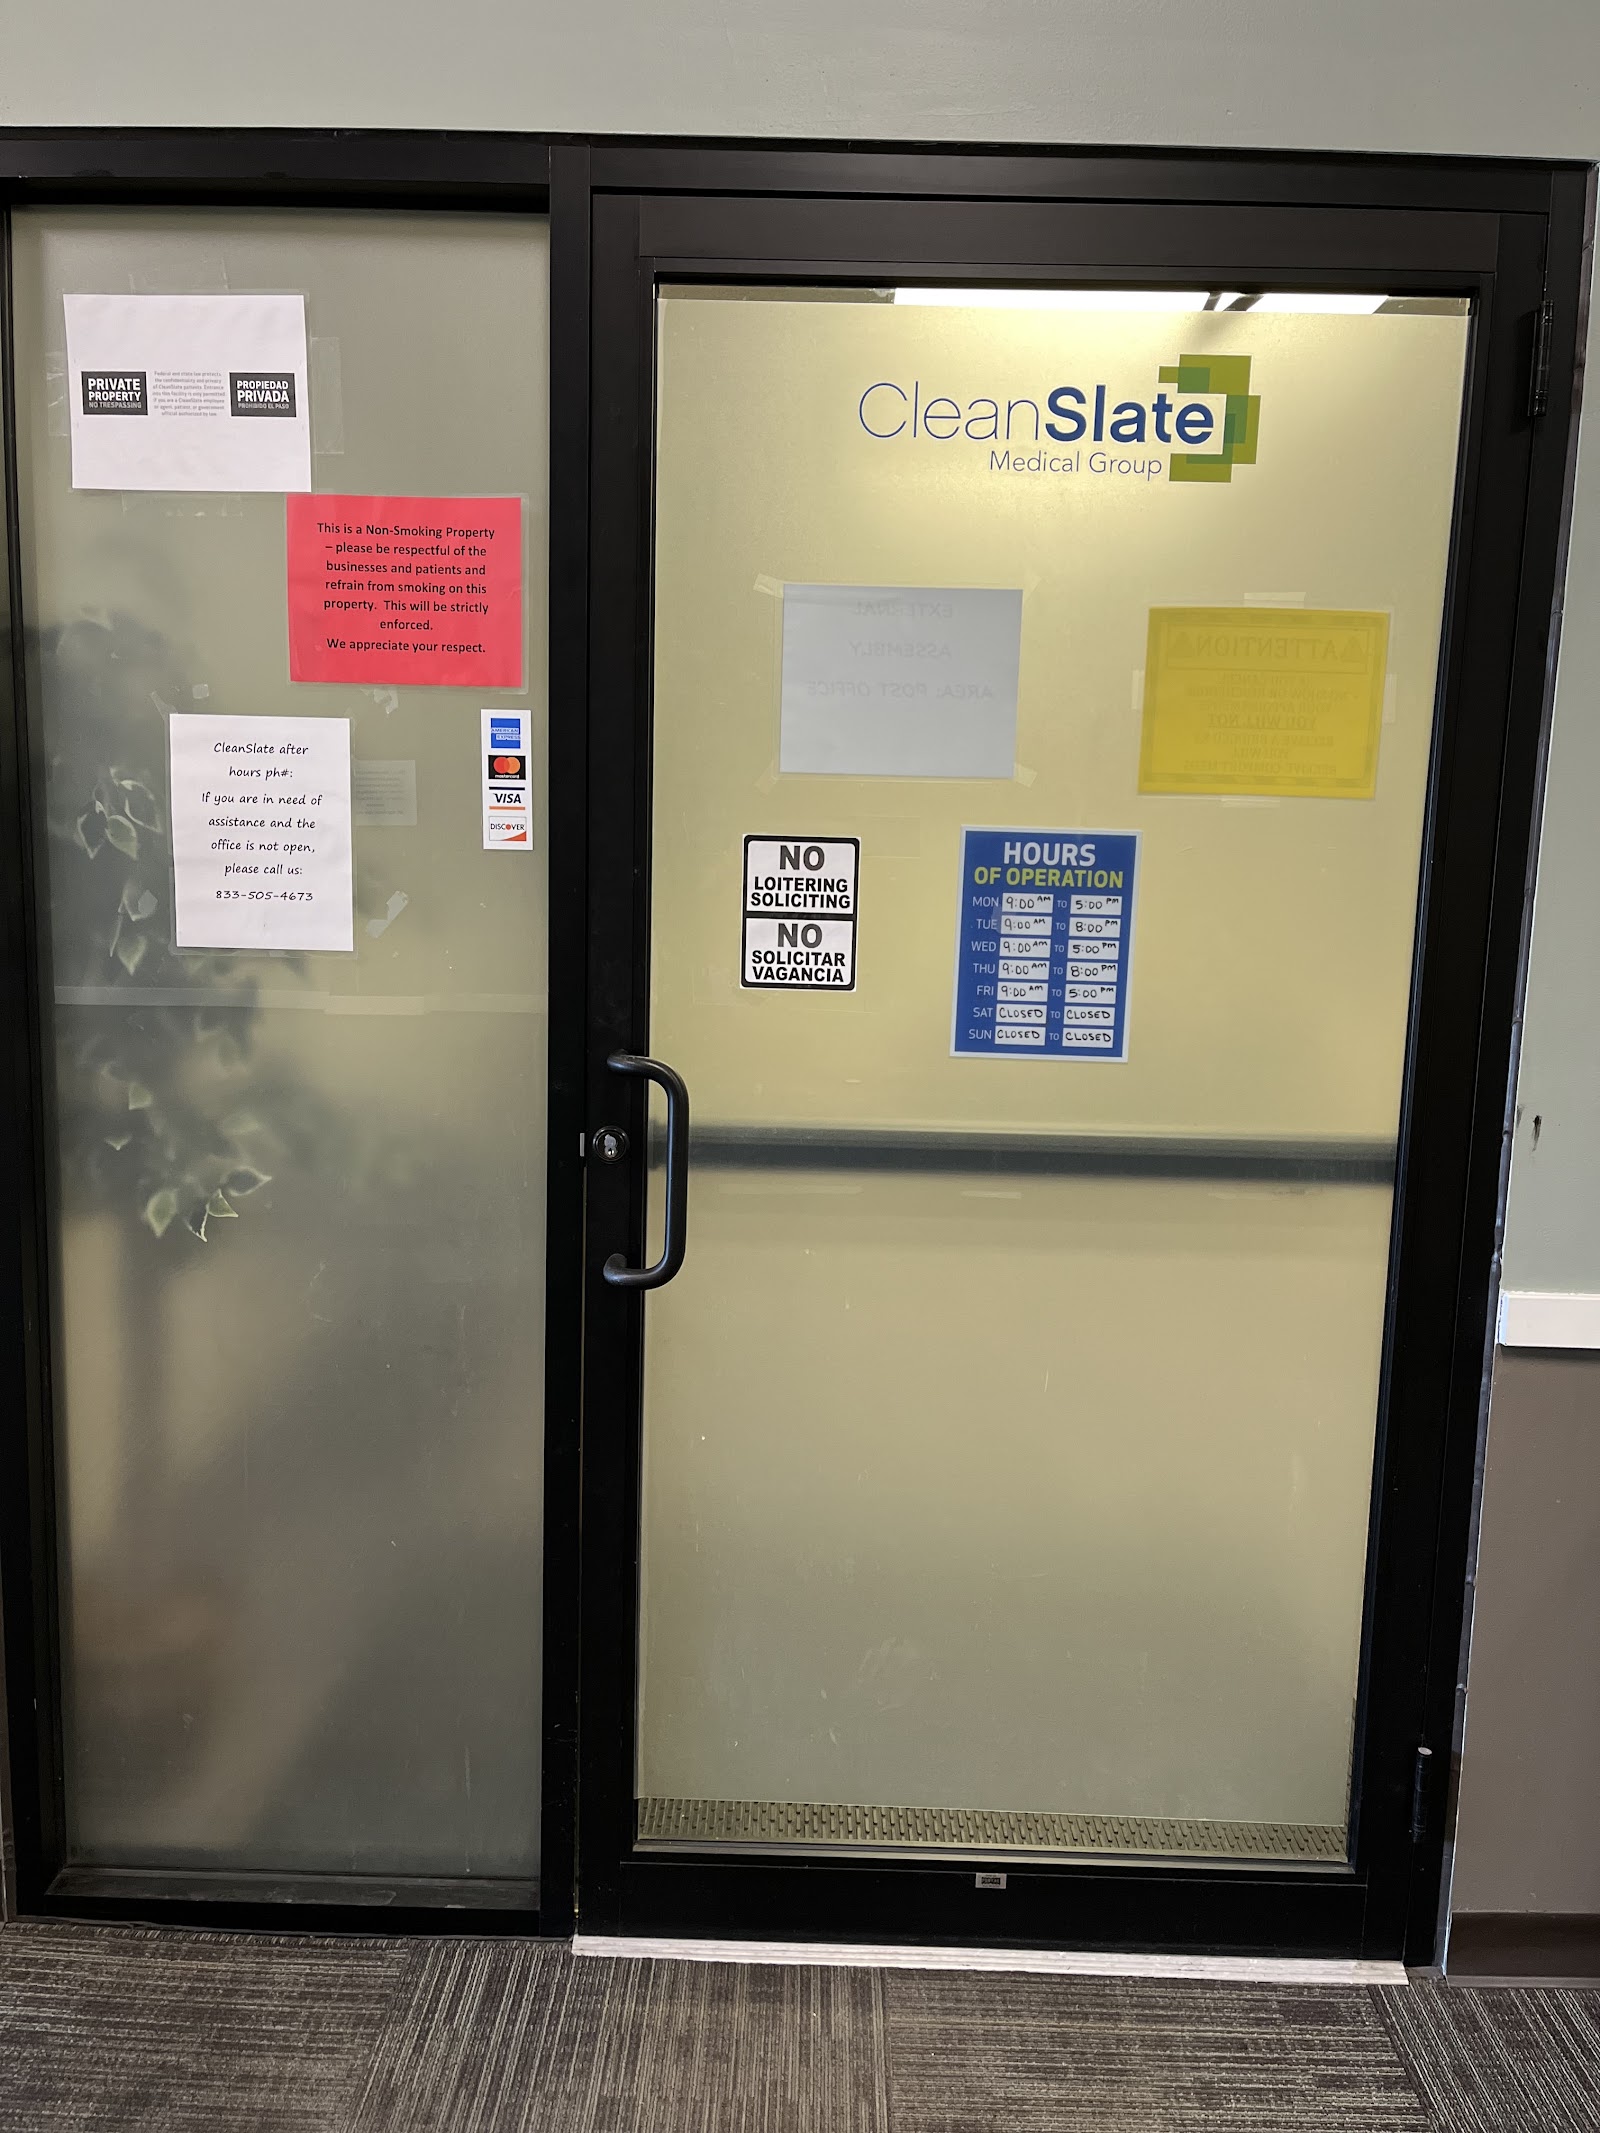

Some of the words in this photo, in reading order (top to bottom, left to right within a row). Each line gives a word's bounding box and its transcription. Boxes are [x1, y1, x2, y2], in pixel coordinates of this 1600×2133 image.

[88, 378, 140, 390] PRIVATE
[237, 381, 288, 390] PROPIEDAD
[89, 391, 140, 401] PROPERTY
[237, 391, 289, 402] PRIVADA
[859, 381, 1215, 445] CleanSlate
[990, 449, 1080, 473] Medical
[1089, 452, 1162, 482] Group
[317, 523, 340, 534] This
[344, 524, 352, 534] is
[356, 526, 362, 535] a
[366, 524, 442, 538] Non-Smoking
[446, 527, 495, 540] Property
[336, 543, 372, 555] please
[377, 543, 390, 554] be
[394, 545, 450, 557] respectful
[453, 546, 465, 556] of
[468, 546, 486, 557] the
[326, 561, 387, 573] businesses
[391, 564, 412, 574] and
[415, 564, 462, 576] patients
[465, 565, 486, 575] and
[325, 580, 364, 591] refrain
[367, 582, 394, 592] from
[398, 583, 445, 595] smoking
[449, 585, 463, 594] on
[466, 583, 487, 594] this
[324, 600, 377, 611] property.
[384, 600, 407, 611] This
[410, 601, 430, 612] will
[433, 601, 447, 612] be
[450, 603, 489, 615] strictly
[380, 620, 433, 631] enforced.
[327, 639, 346, 649] We
[349, 639, 409, 652] appreciate
[412, 643, 438, 653] your
[441, 643, 486, 654] respect.
[214, 742, 274, 754] CleanSlate
[279, 743, 308, 755] after
[229, 766, 261, 778] hours
[266, 767, 293, 781] ph#:
[202, 792, 210, 803] If
[215, 795, 234, 807] you
[239, 795, 258, 804] are
[263, 794, 274, 804] in
[279, 795, 305, 805] need
[311, 795, 323, 806] of
[493, 794, 521, 804] VISA
[209, 817, 265, 828] assistance
[270, 818, 292, 828] and
[297, 818, 316, 829] the
[211, 840, 241, 851] office
[246, 841, 255, 851] is
[260, 842, 279, 851] not
[284, 843, 315, 854] open,
[1003, 841, 1096, 867] HOURS
[780, 845, 825, 871] NO
[225, 864, 259, 876] please
[264, 865, 283, 875] call
[287, 867, 303, 875] us:
[754, 876, 848, 893] LOITERING
[974, 867, 1001, 885] OF
[1006, 868, 1123, 888] OPERATION
[216, 890, 313, 901] 833-505-4673
[751, 892, 850, 909] SOLICITING
[972, 896, 999, 907] MON
[1058, 900, 1067, 908] TO
[1076, 900, 1102, 910] 5:00
[976, 919, 997, 929] TUE
[1056, 922, 1066, 930] TO
[1076, 921, 1102, 933] 8:00
[778, 923, 822, 948] NO
[971, 942, 996, 952] WED
[1072, 944, 1099, 954] 5:00
[752, 950, 845, 966] SOLICITAR
[752, 966, 844, 982] VAGANCIA
[973, 963, 995, 974] THU
[1053, 967, 1063, 975] TO
[1071, 966, 1098, 977] 8:00
[977, 985, 993, 996] FRI
[1052, 989, 1062, 997] TO
[1069, 988, 1097, 998] 5:00
[973, 1008, 993, 1017] SAT
[1000, 1008, 1043, 1018] CLOSED
[1050, 1011, 1060, 1019] TO
[1067, 1010, 1110, 1019] CLOSED
[969, 1029, 992, 1039] SUN
[997, 1029, 1040, 1039] CLOSED
[1066, 1032, 1111, 1042] CLOSED
